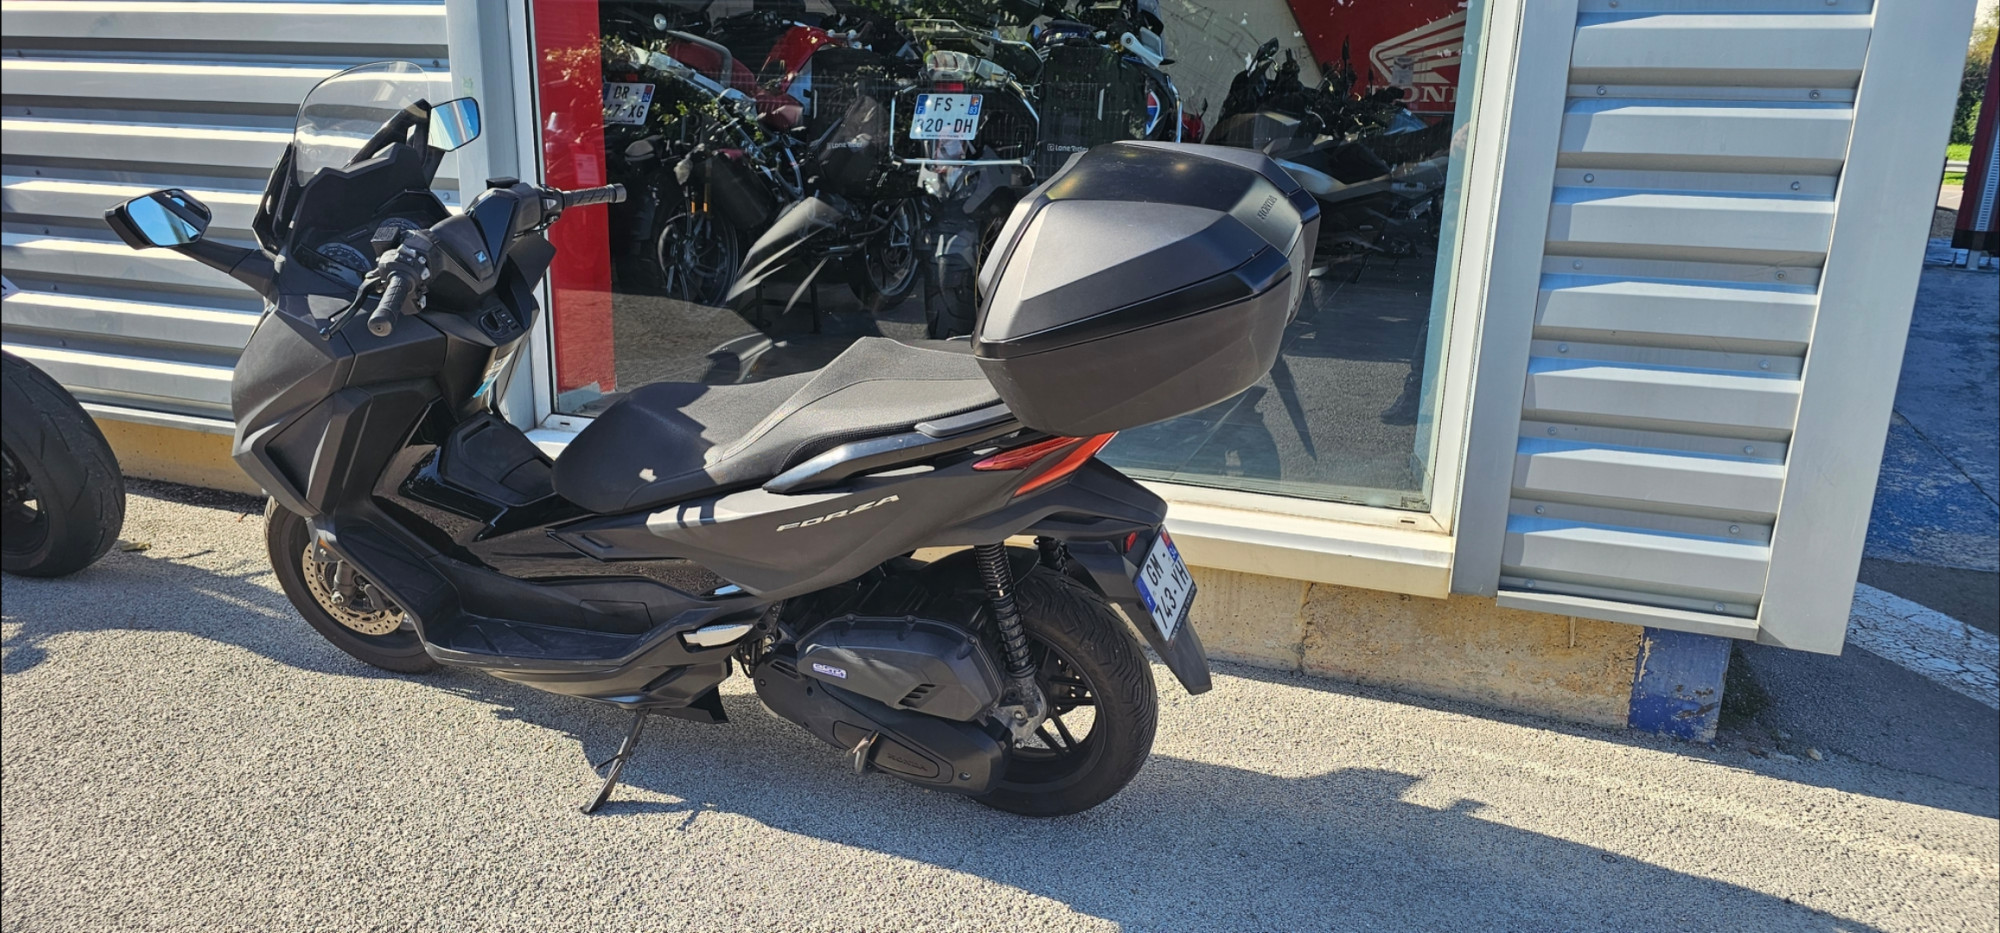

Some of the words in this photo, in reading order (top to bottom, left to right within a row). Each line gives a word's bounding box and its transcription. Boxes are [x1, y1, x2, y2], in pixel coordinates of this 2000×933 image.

[613, 86, 630, 99] DR
[1367, 84, 1458, 103] ON
[602, 104, 645, 118] 7-XG
[934, 97, 953, 111] FS
[1257, 195, 1278, 220] HONDA
[776, 494, 900, 532] FORZA
[1145, 553, 1164, 587] GM
[1154, 560, 1189, 630] 743-YH
